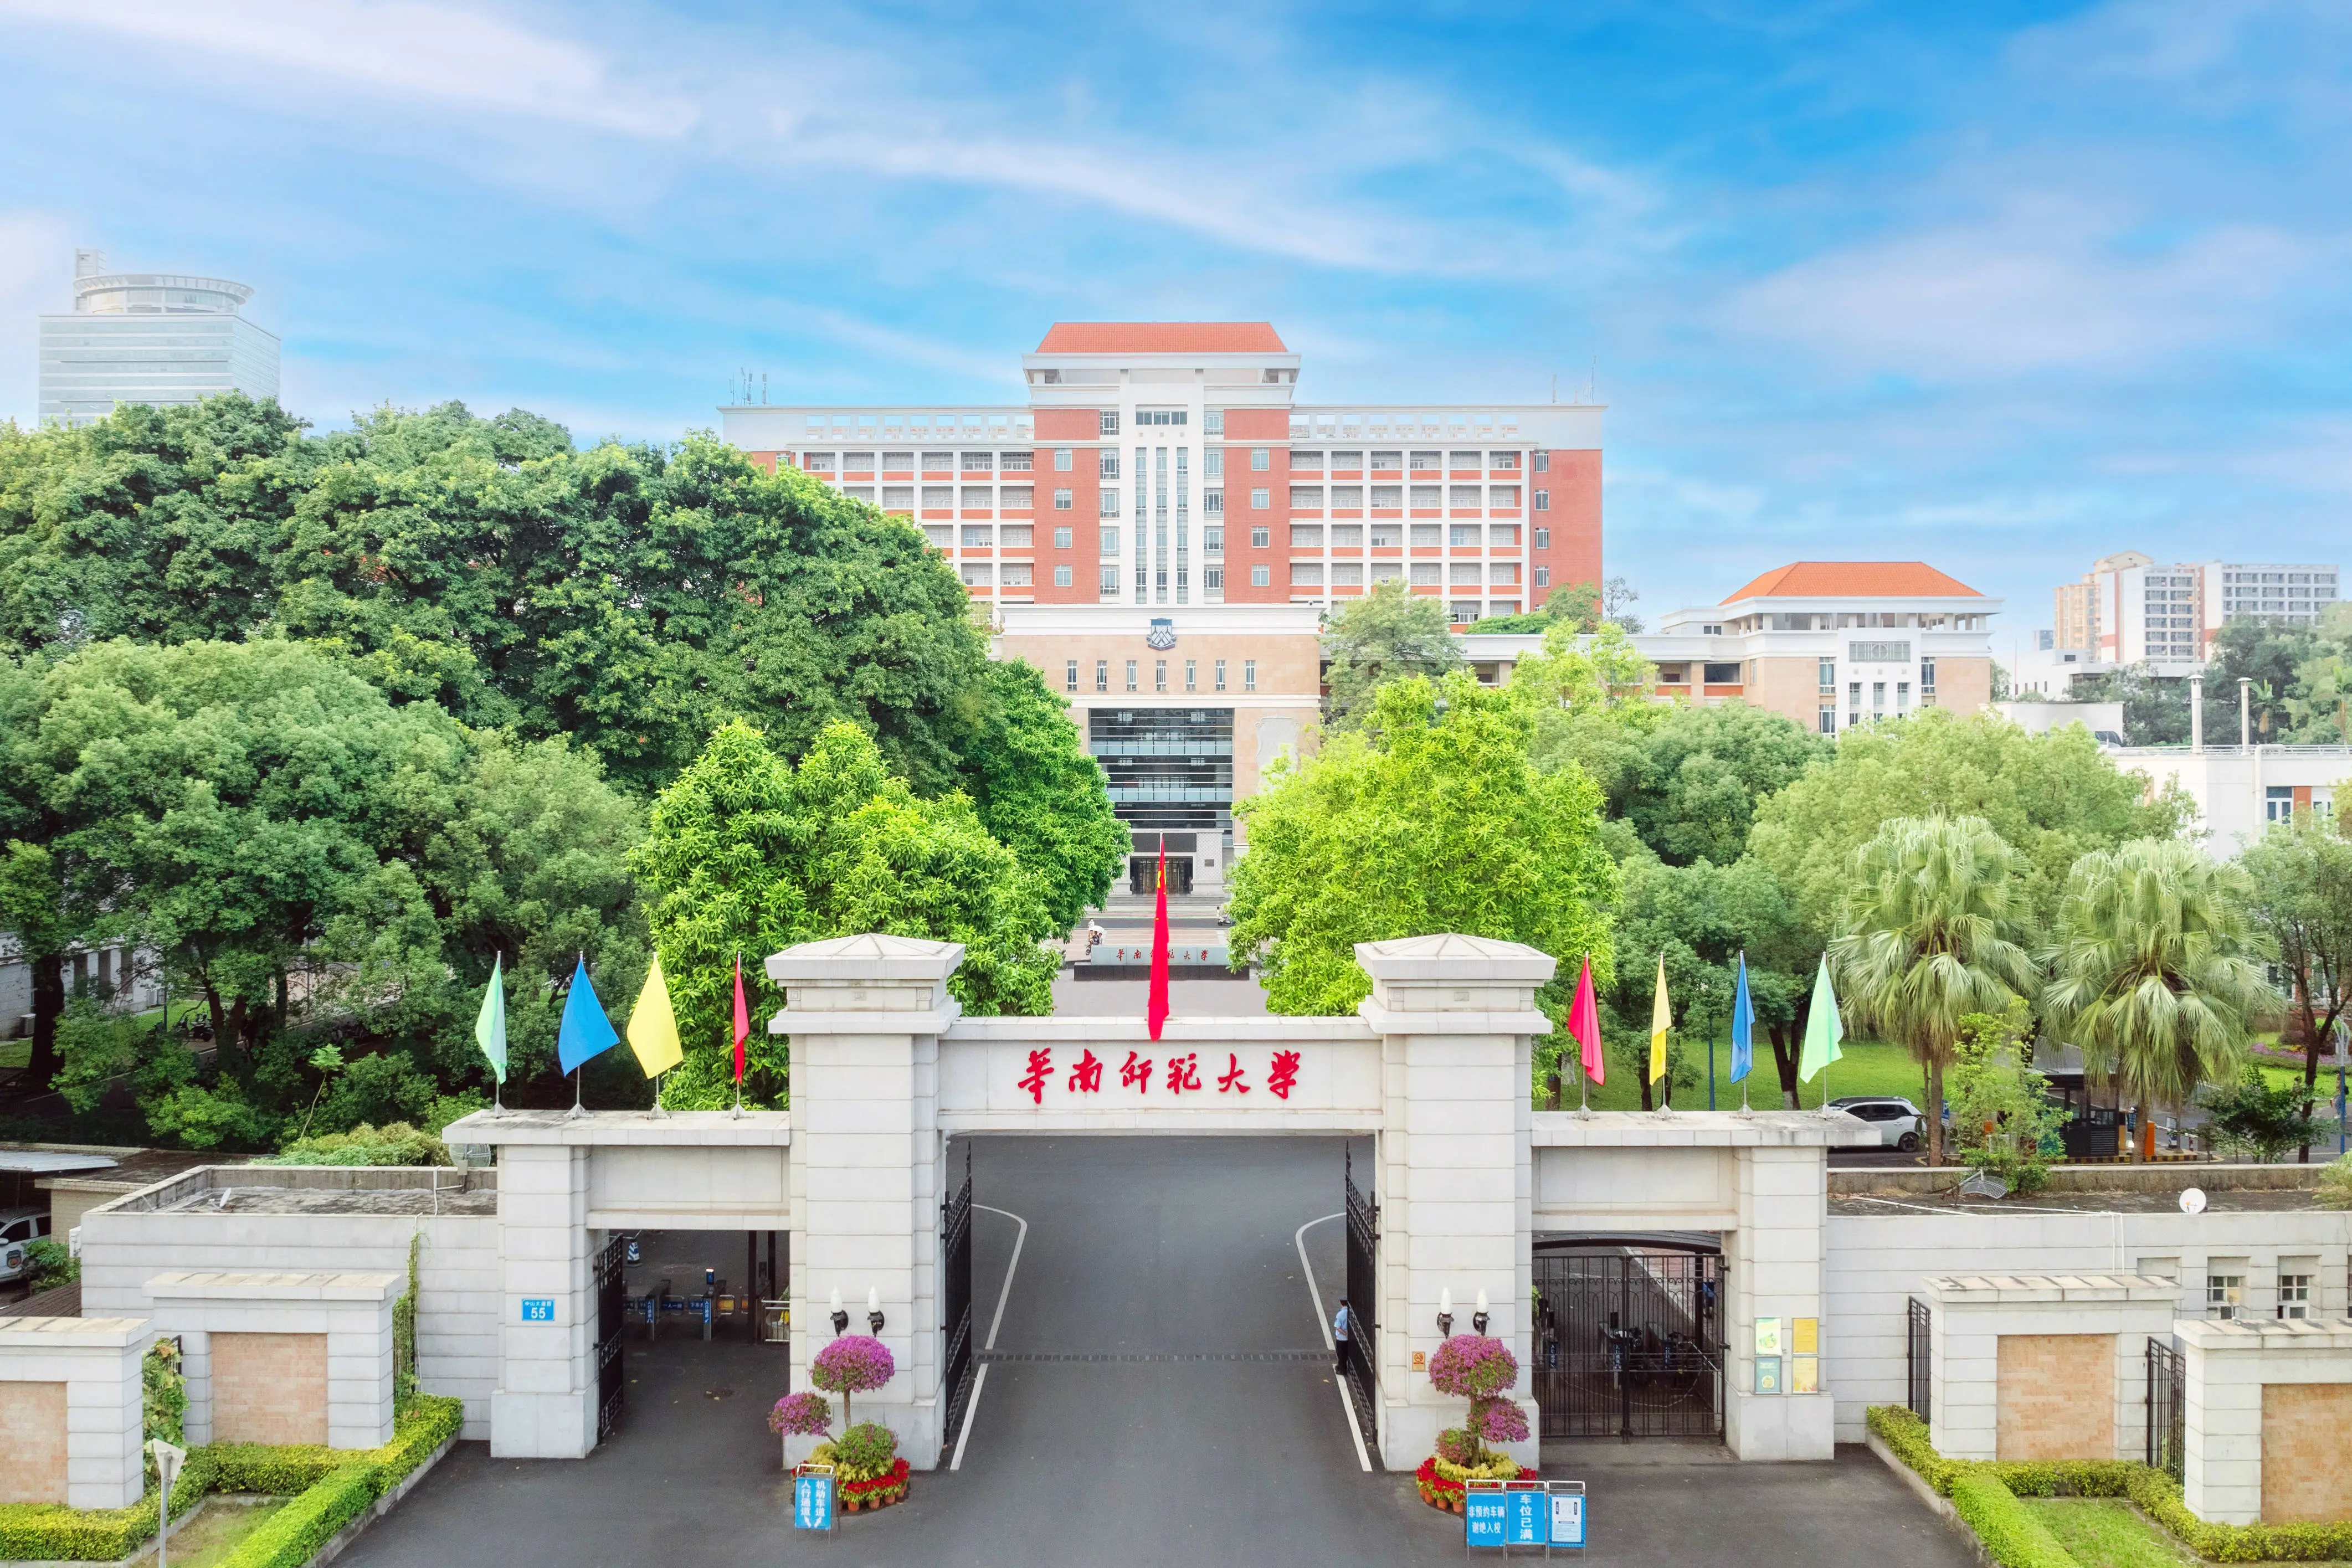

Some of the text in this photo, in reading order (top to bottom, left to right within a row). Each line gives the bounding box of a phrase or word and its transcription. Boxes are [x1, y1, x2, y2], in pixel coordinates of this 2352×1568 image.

[531, 1307, 546, 1319] 55
[800, 1480, 811, 1516] 人行通道
[815, 1480, 826, 1516] 机动车道
[1468, 1505, 1504, 1518] 非预约车辆
[1519, 1494, 1533, 1540] 车位已满
[1472, 1521, 1501, 1534] 谢绝入校
